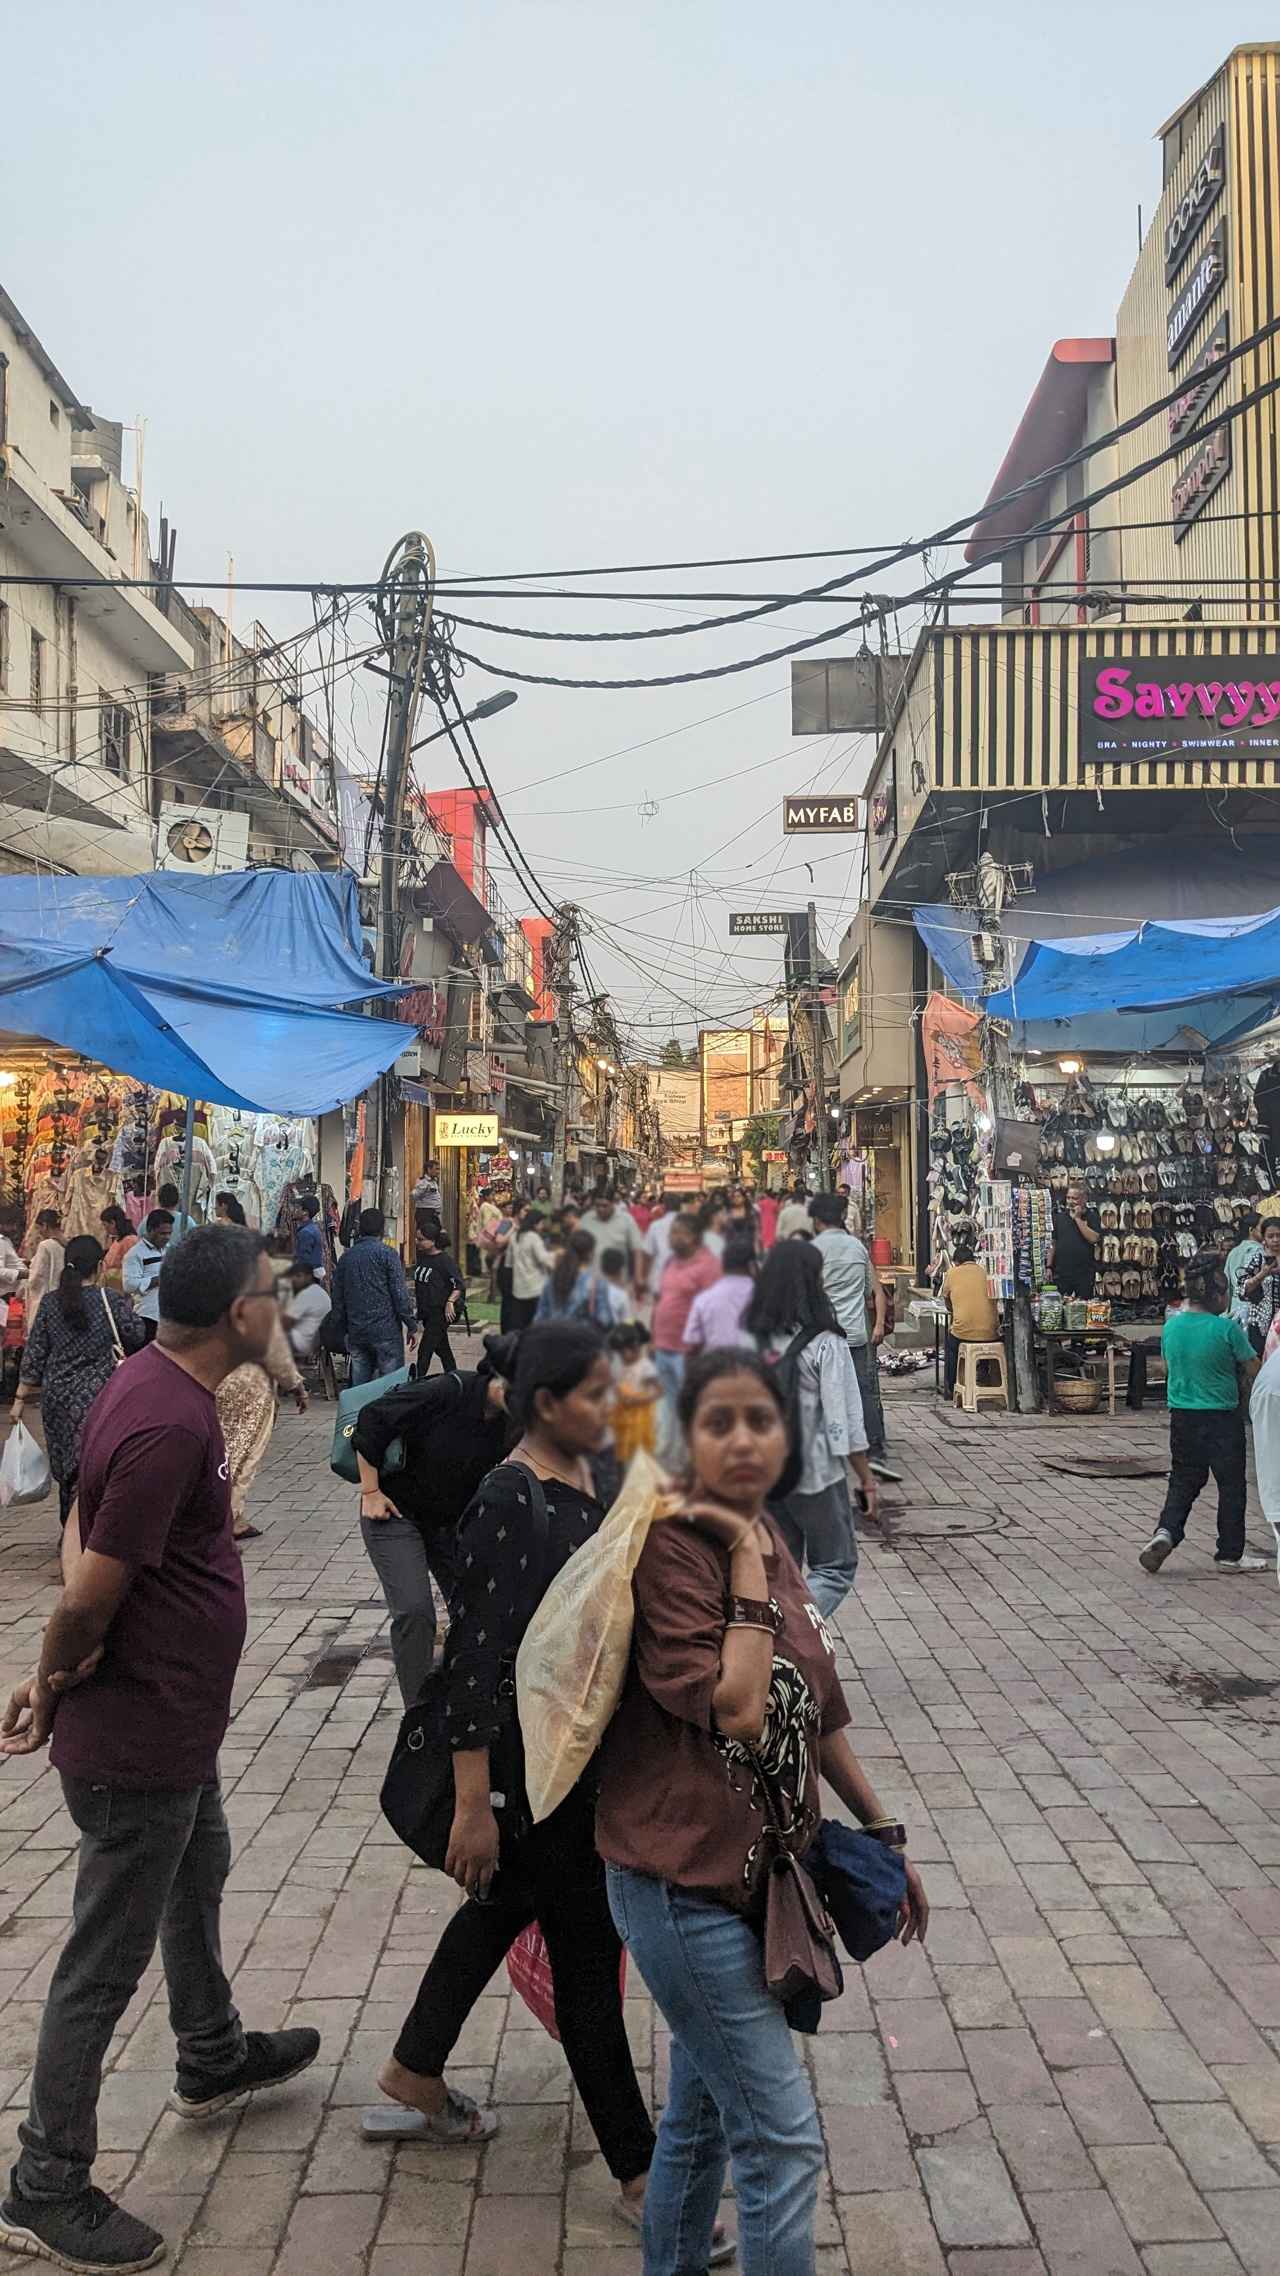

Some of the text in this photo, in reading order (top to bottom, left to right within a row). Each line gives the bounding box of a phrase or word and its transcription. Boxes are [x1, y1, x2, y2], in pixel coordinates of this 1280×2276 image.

[1167, 146, 1217, 262] JOCKEY
[1167, 254, 1217, 352] amante
[1097, 741, 1118, 749] BRA
[1131, 740, 1168, 748] NIGHTY
[1181, 739, 1235, 748] SWIMWEAR
[788, 806, 855, 824] MYFAB
[736, 915, 783, 925] SAKSHI
[759, 924, 784, 932] STORE
[451, 1123, 495, 1137] Lucky
